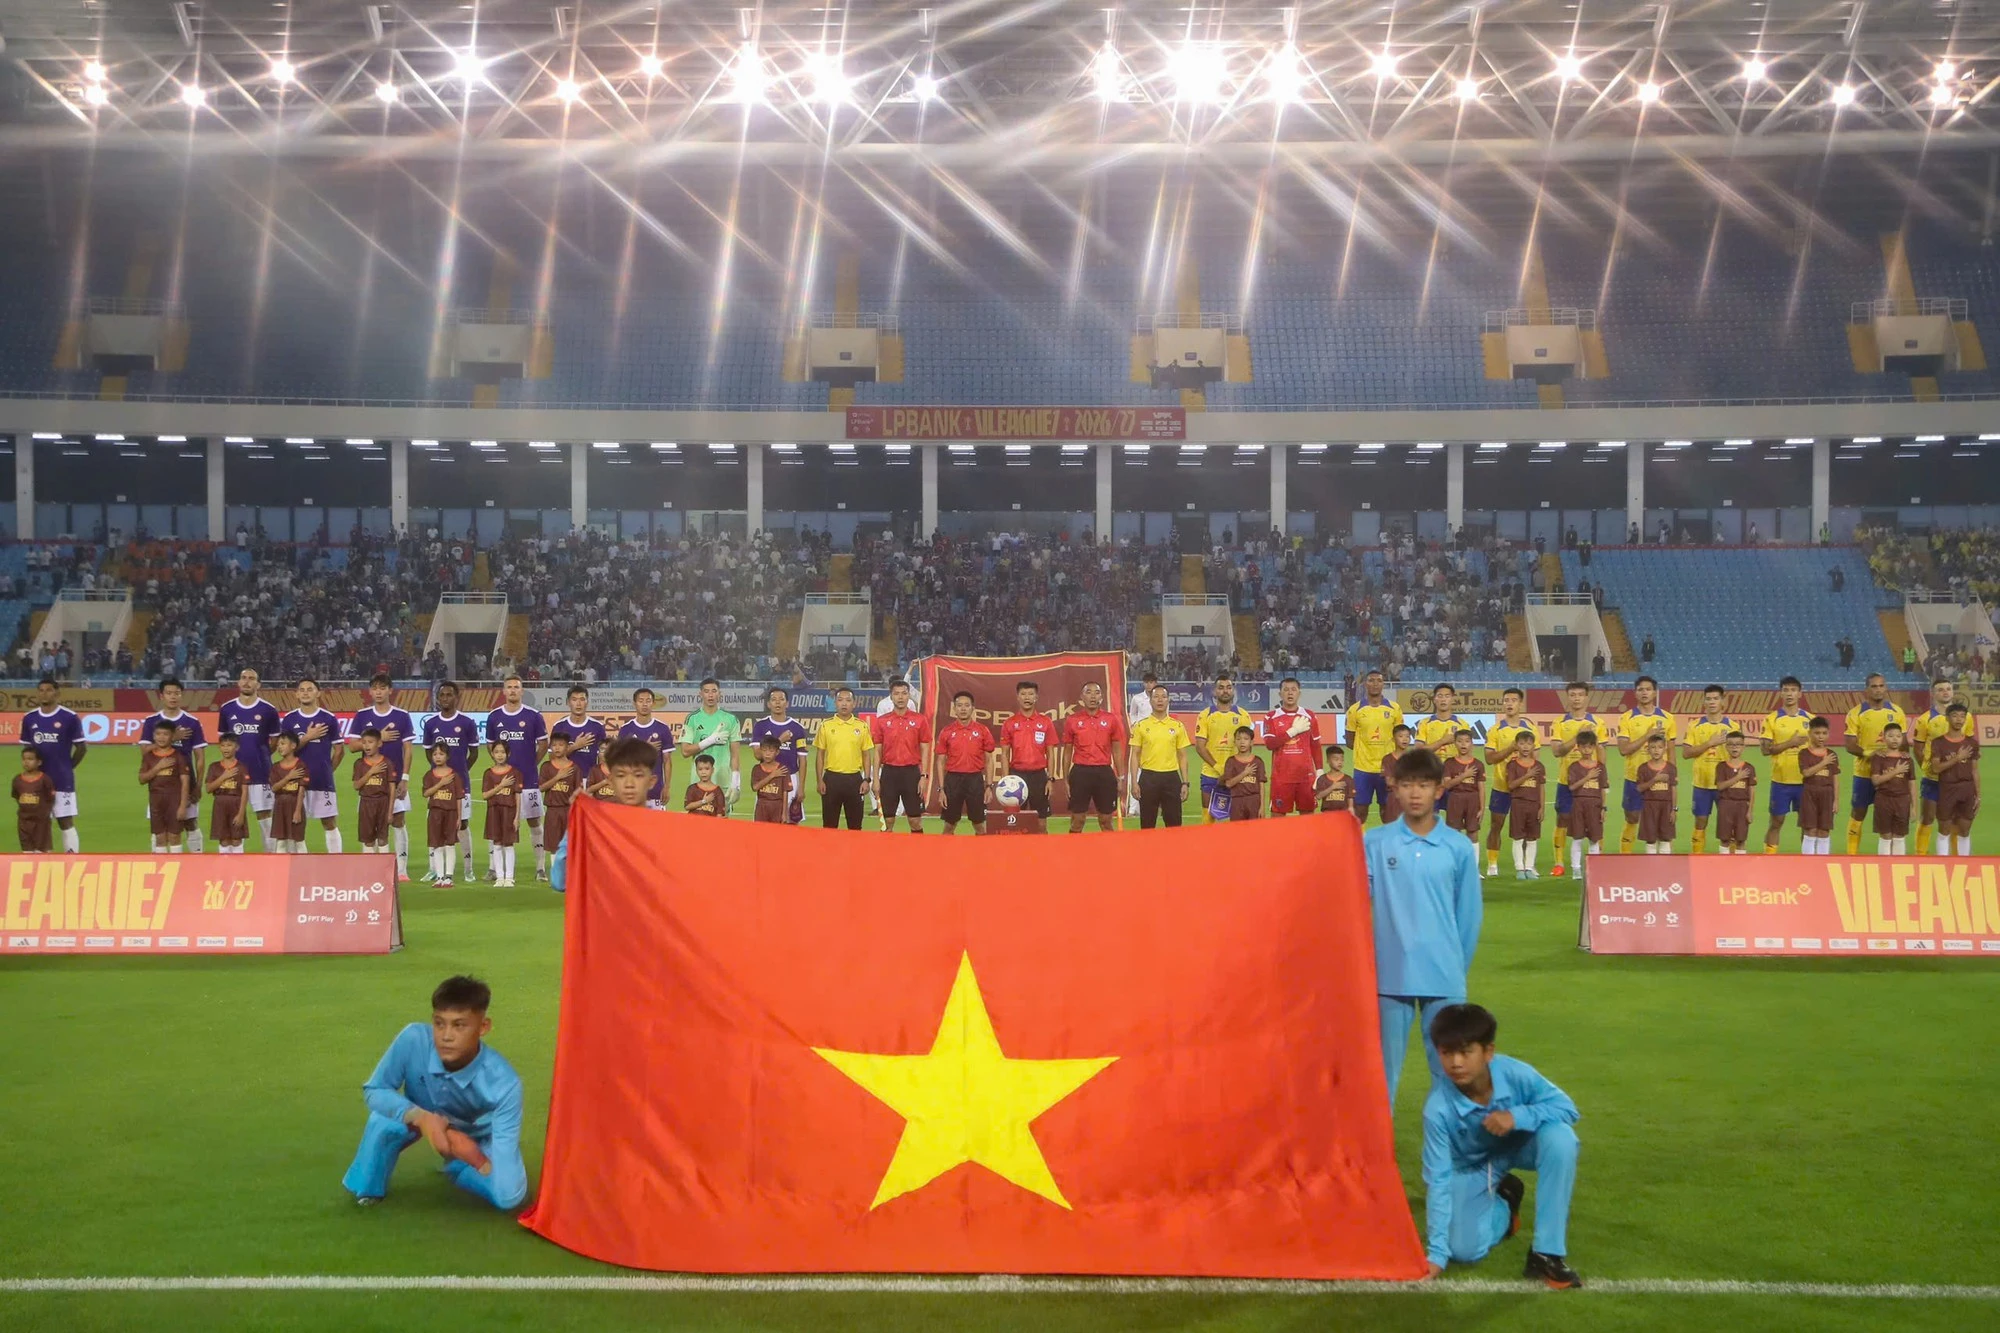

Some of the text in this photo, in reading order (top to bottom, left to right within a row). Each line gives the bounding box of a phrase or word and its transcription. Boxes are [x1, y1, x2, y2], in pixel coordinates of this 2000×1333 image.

[882, 409, 962, 436] LPBANK
[1074, 409, 1136, 436] 2026/27
[64, 700, 103, 708] OMES
[545, 697, 562, 706] IPC
[668, 692, 685, 704] CÔNG
[687, 694, 696, 704] TY
[1472, 698, 1504, 706] GROU
[528, 792, 538, 801] 36
[0, 861, 181, 930] EAGUE1
[203, 880, 254, 910] 26/27
[300, 886, 370, 902] LPBank
[1599, 886, 1670, 902] LPBank
[1719, 887, 1799, 905] LPBank
